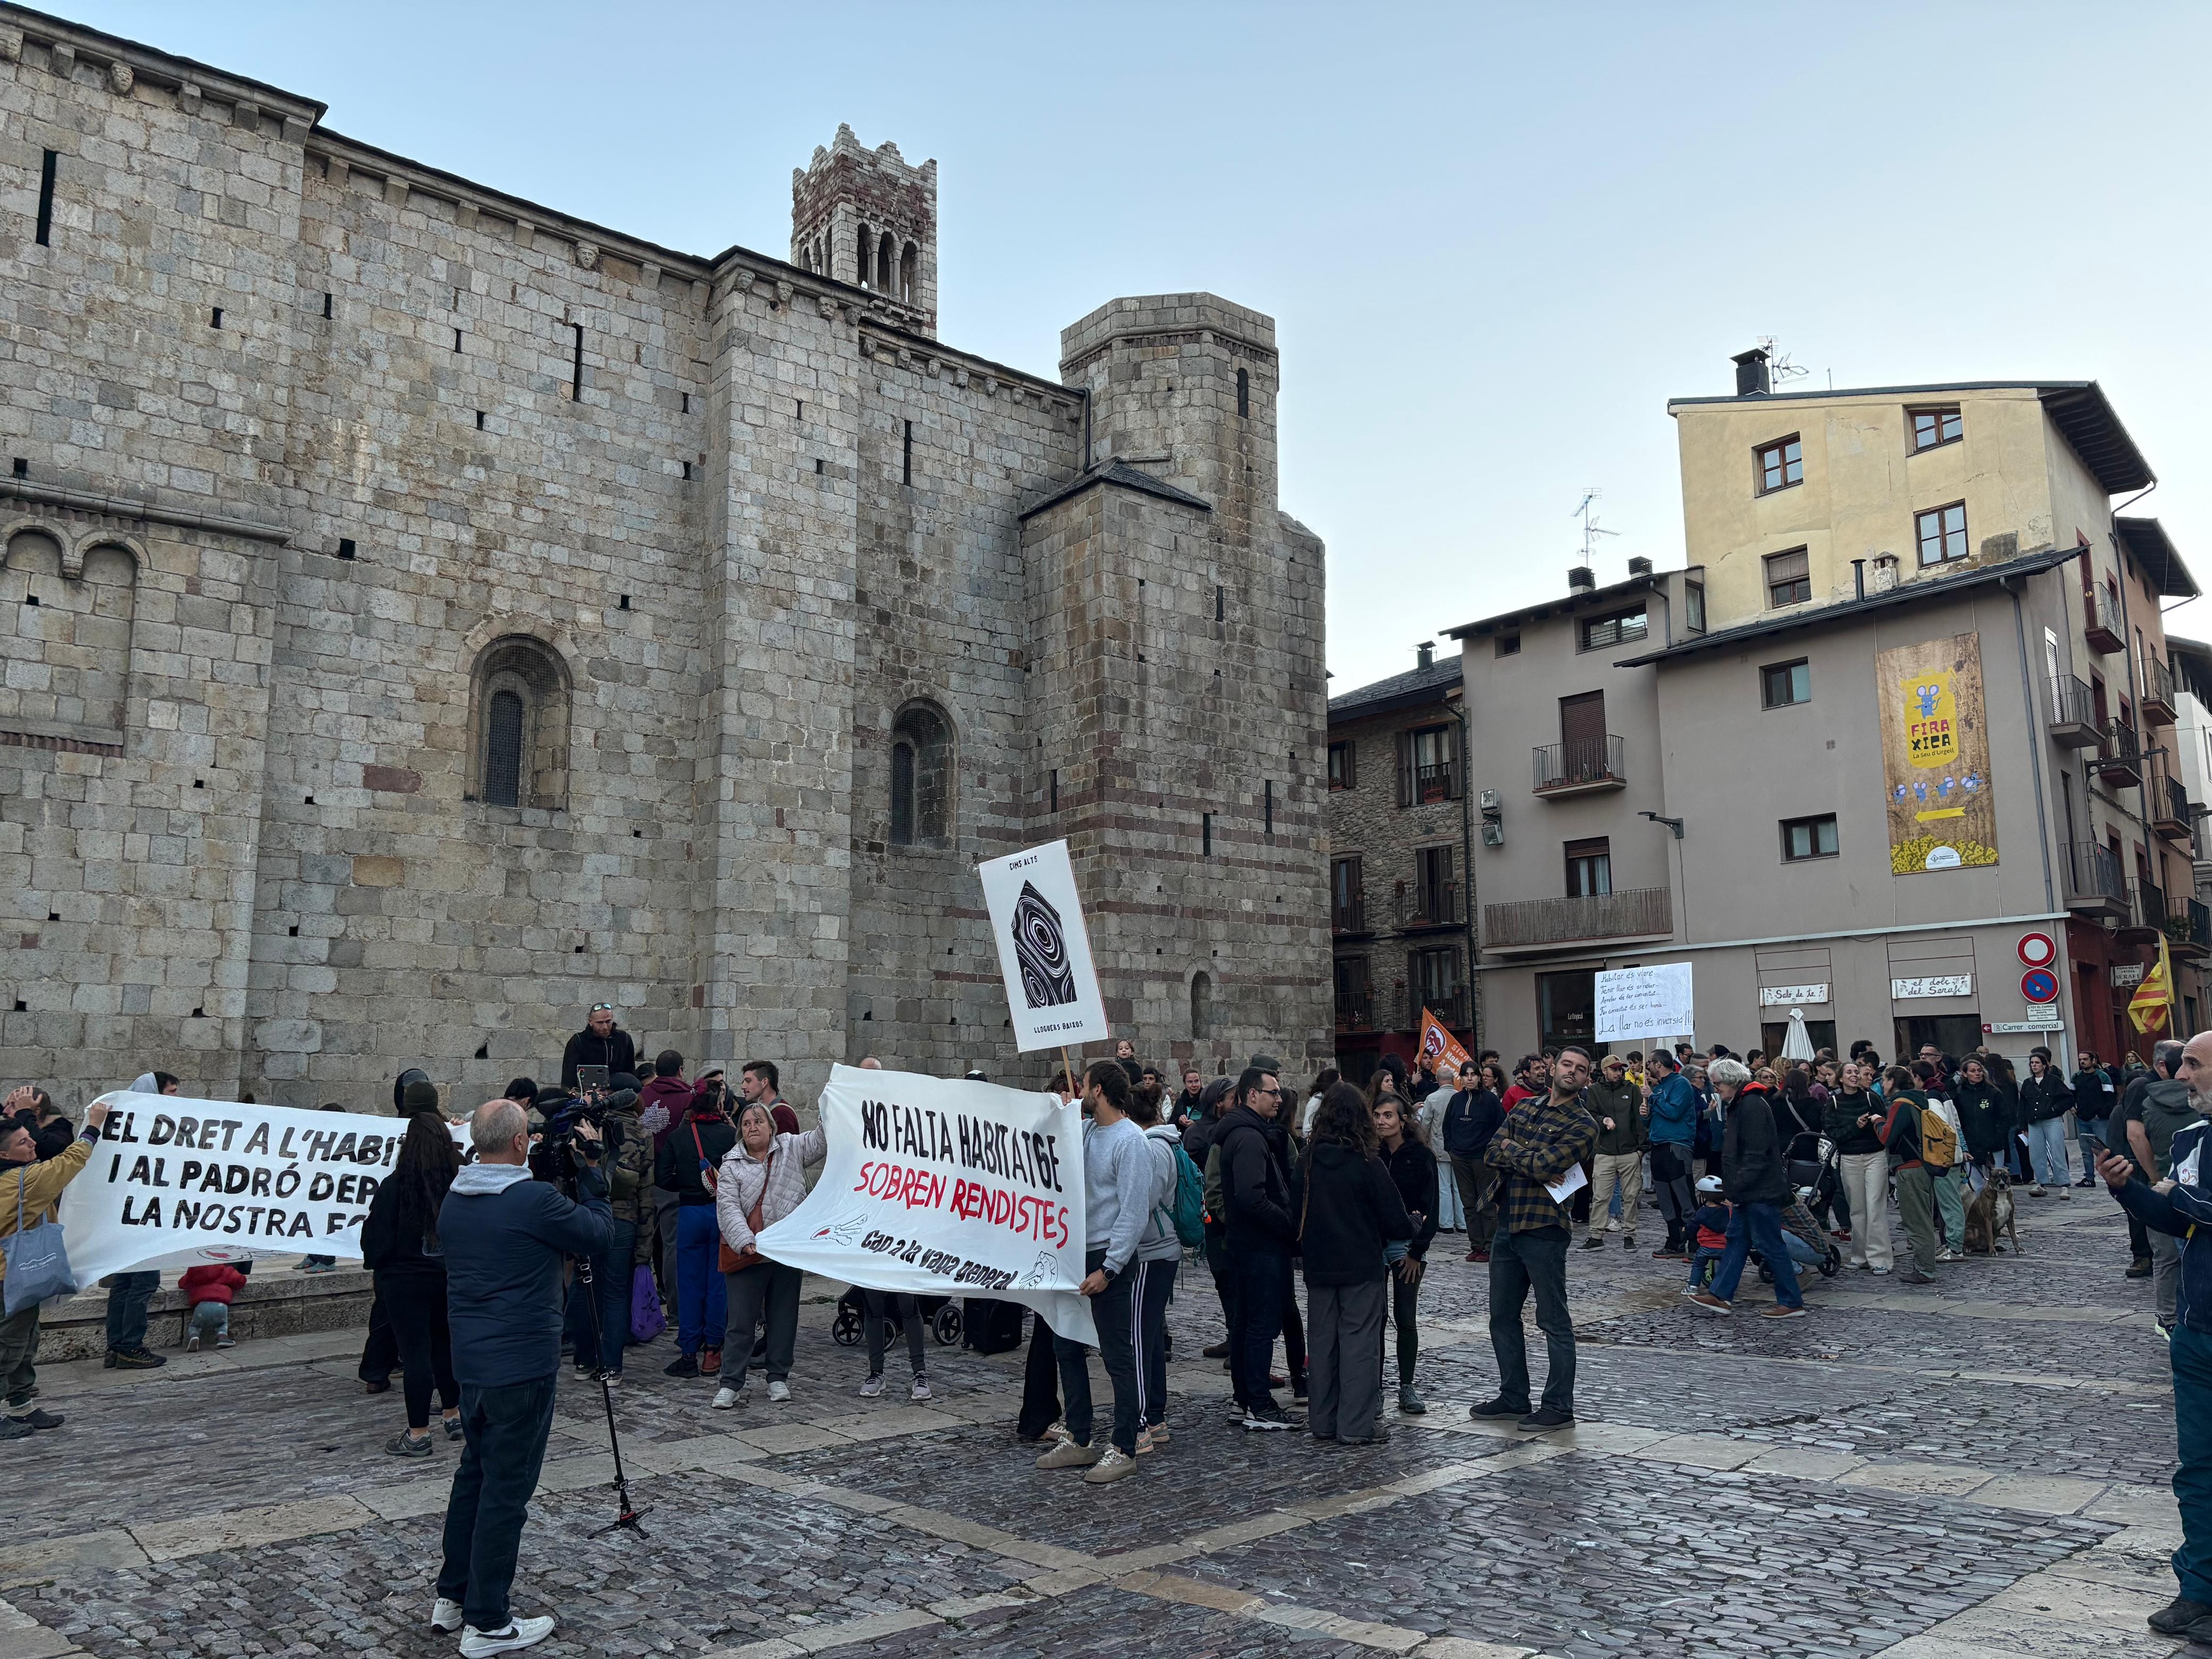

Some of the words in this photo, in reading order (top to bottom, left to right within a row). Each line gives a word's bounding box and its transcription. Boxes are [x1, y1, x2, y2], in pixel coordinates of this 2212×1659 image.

[1911, 719, 1949, 737] FIRA
[1911, 734, 1950, 751] XICA
[1024, 855, 1038, 866] ALTS
[1601, 973, 1624, 983] Habitar
[1774, 989, 1792, 999] Saló
[1796, 988, 1804, 998] de
[1807, 988, 1815, 998] te
[1908, 987, 1924, 995] del
[1034, 1024, 1060, 1033] LLOGUERS
[1062, 1020, 1083, 1029] BAIXOS
[1598, 1017, 1614, 1035] La
[1619, 1014, 1631, 1030] llar
[1644, 1017, 1654, 1027] és
[102, 1111, 139, 1143] EL
[148, 1114, 242, 1151] DRET
[244, 1122, 269, 1155] A
[861, 1100, 888, 1152] NO
[892, 1104, 954, 1163] FALTA
[958, 1113, 1062, 1193] HABITATGE
[108, 1154, 121, 1183] I
[127, 1155, 170, 1187] AL
[180, 1160, 301, 1199] PADRÓ
[308, 1171, 380, 1204] DEP
[854, 1161, 946, 1210] SOBREN
[950, 1178, 1069, 1249] RENDISTES
[121, 1195, 162, 1227] LA
[173, 1199, 313, 1238] NOSTRA
[861, 1230, 894, 1253] Cap
[888, 1239, 906, 1257] a
[900, 1240, 923, 1264] la
[919, 1249, 960, 1276] vaga
[954, 1260, 1019, 1290] general
